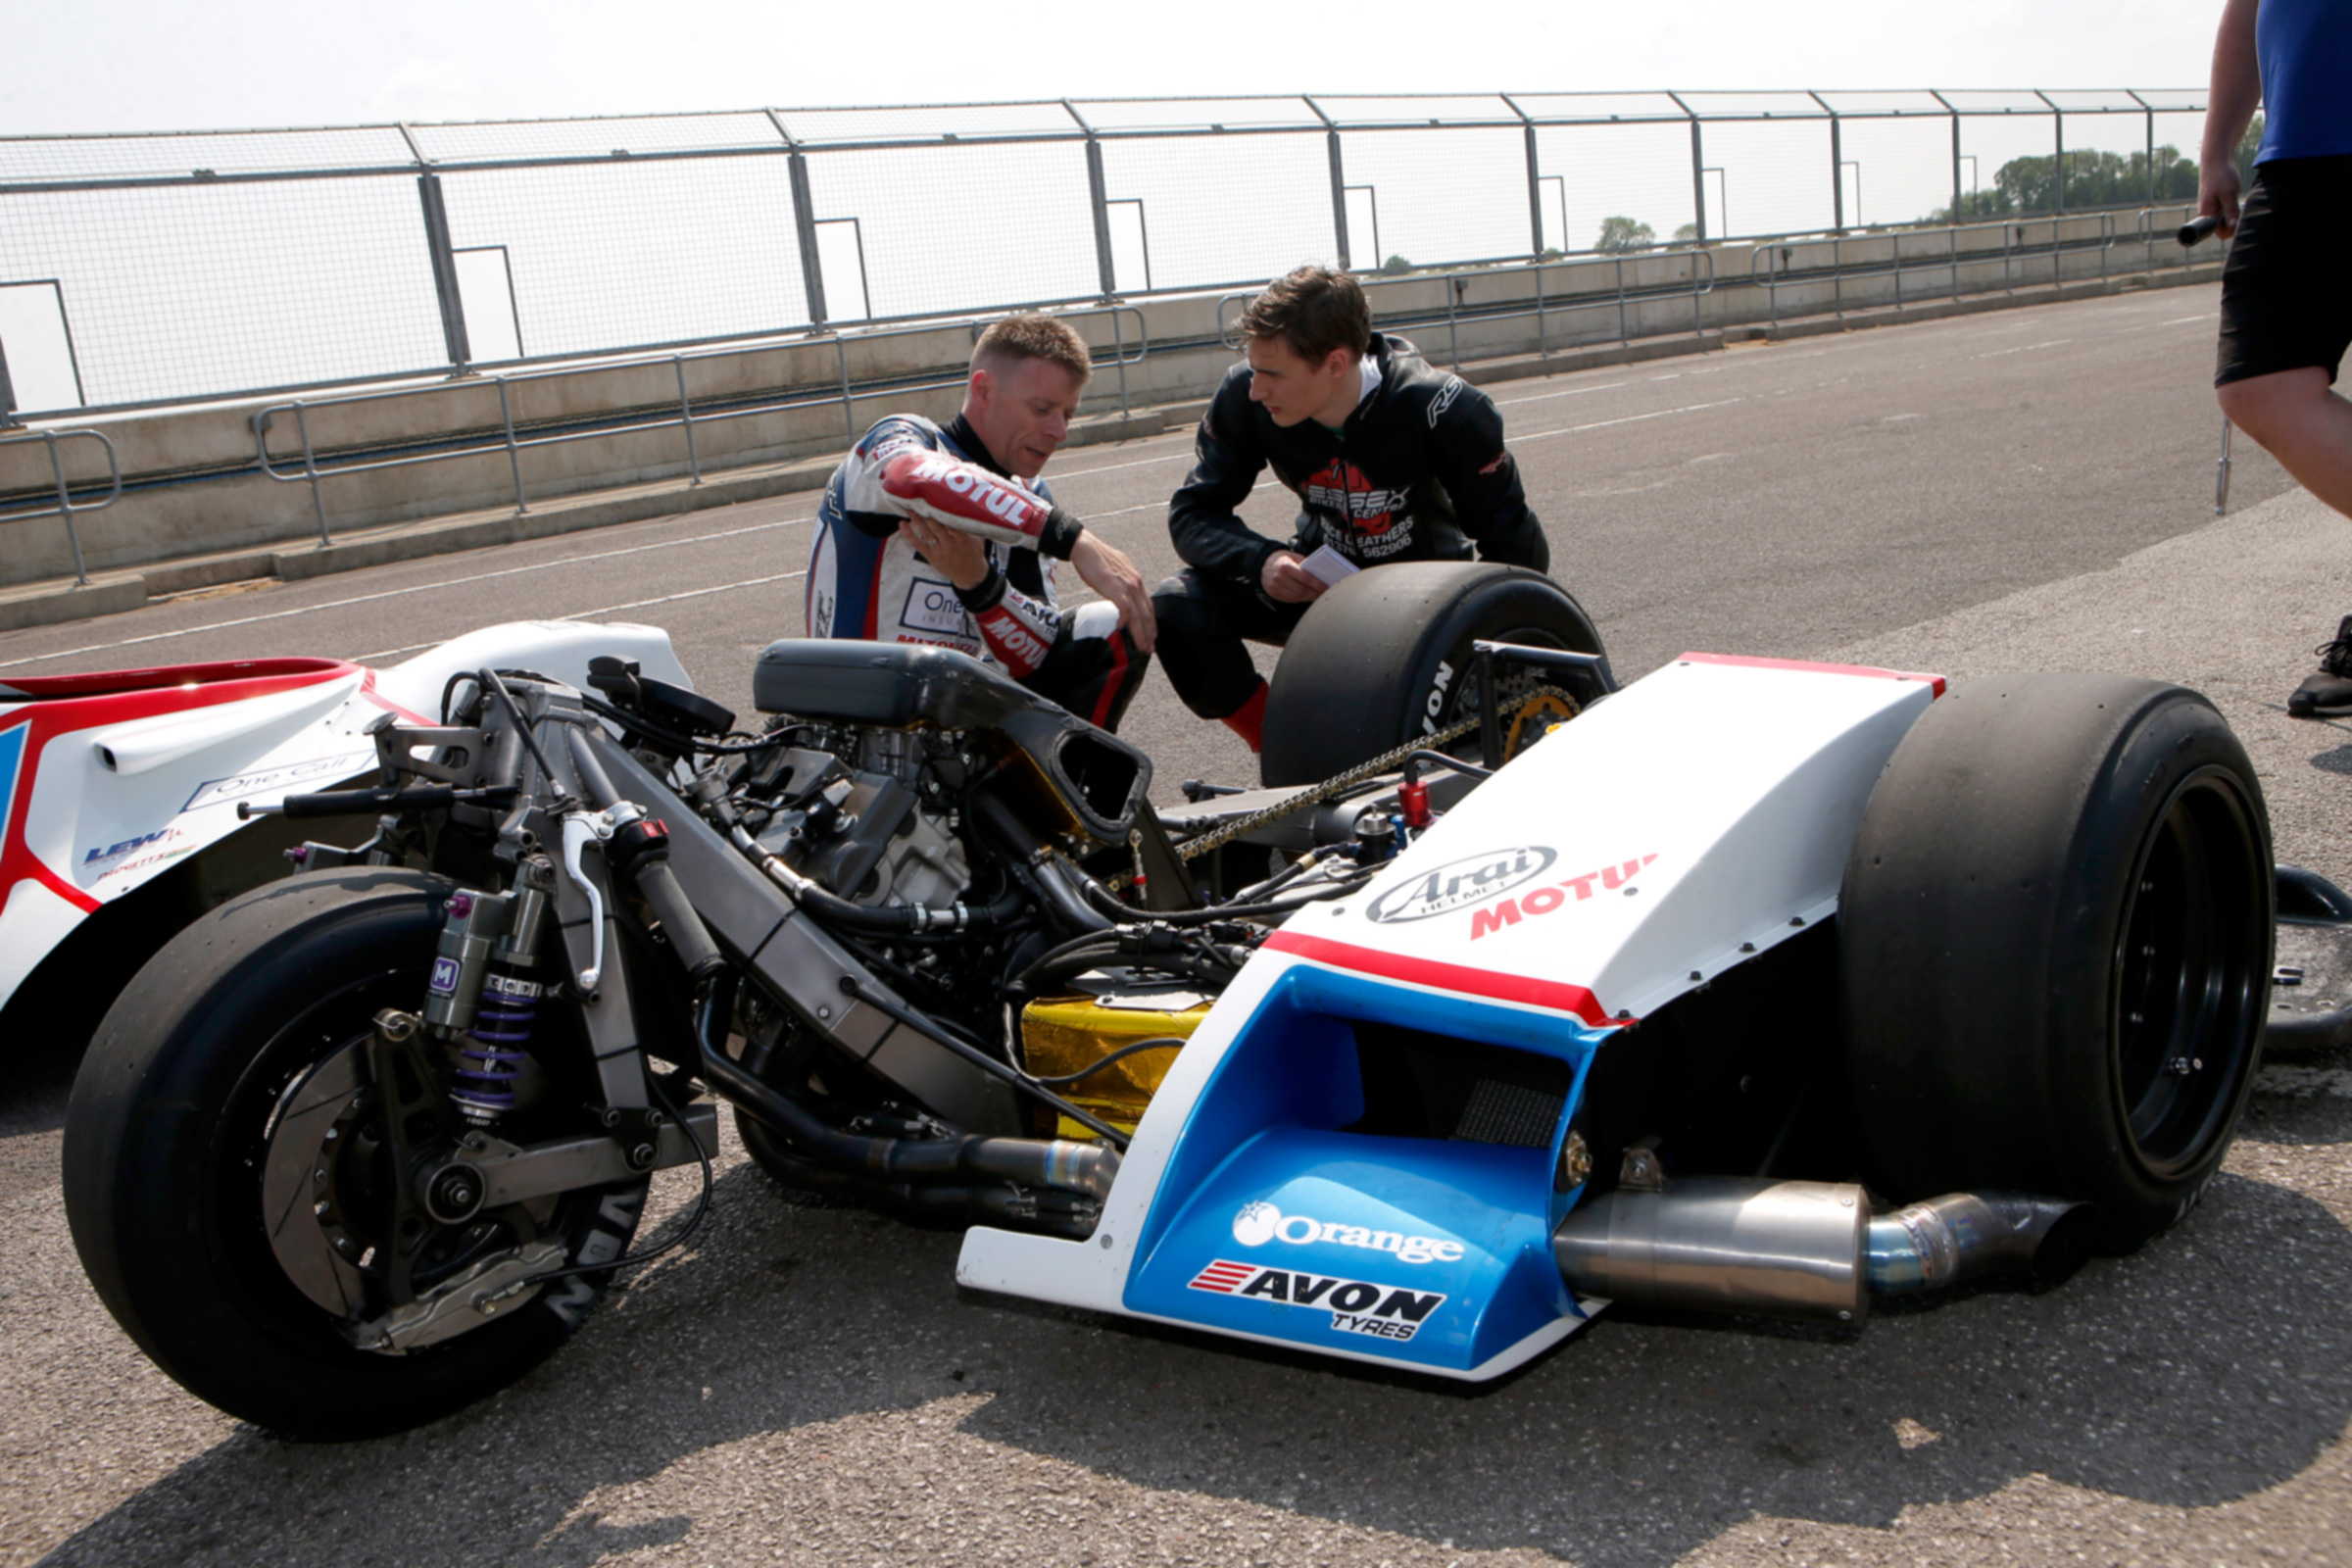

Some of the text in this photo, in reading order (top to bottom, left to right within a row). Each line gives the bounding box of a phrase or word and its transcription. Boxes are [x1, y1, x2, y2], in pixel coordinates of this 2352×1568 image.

[907, 455, 1029, 527] MOTUL
[1308, 485, 1410, 510] ESSEX
[1346, 515, 1413, 548] LEATHERS
[1363, 533, 1412, 558] 562906
[924, 591, 962, 613] One
[218, 758, 348, 793] One Call
[1394, 849, 1537, 911] Arai
[1421, 881, 1505, 913] HELMET
[1275, 1215, 1465, 1264] Orange
[1241, 1270, 1444, 1322] AVON
[1333, 1314, 1416, 1340] TYRES
